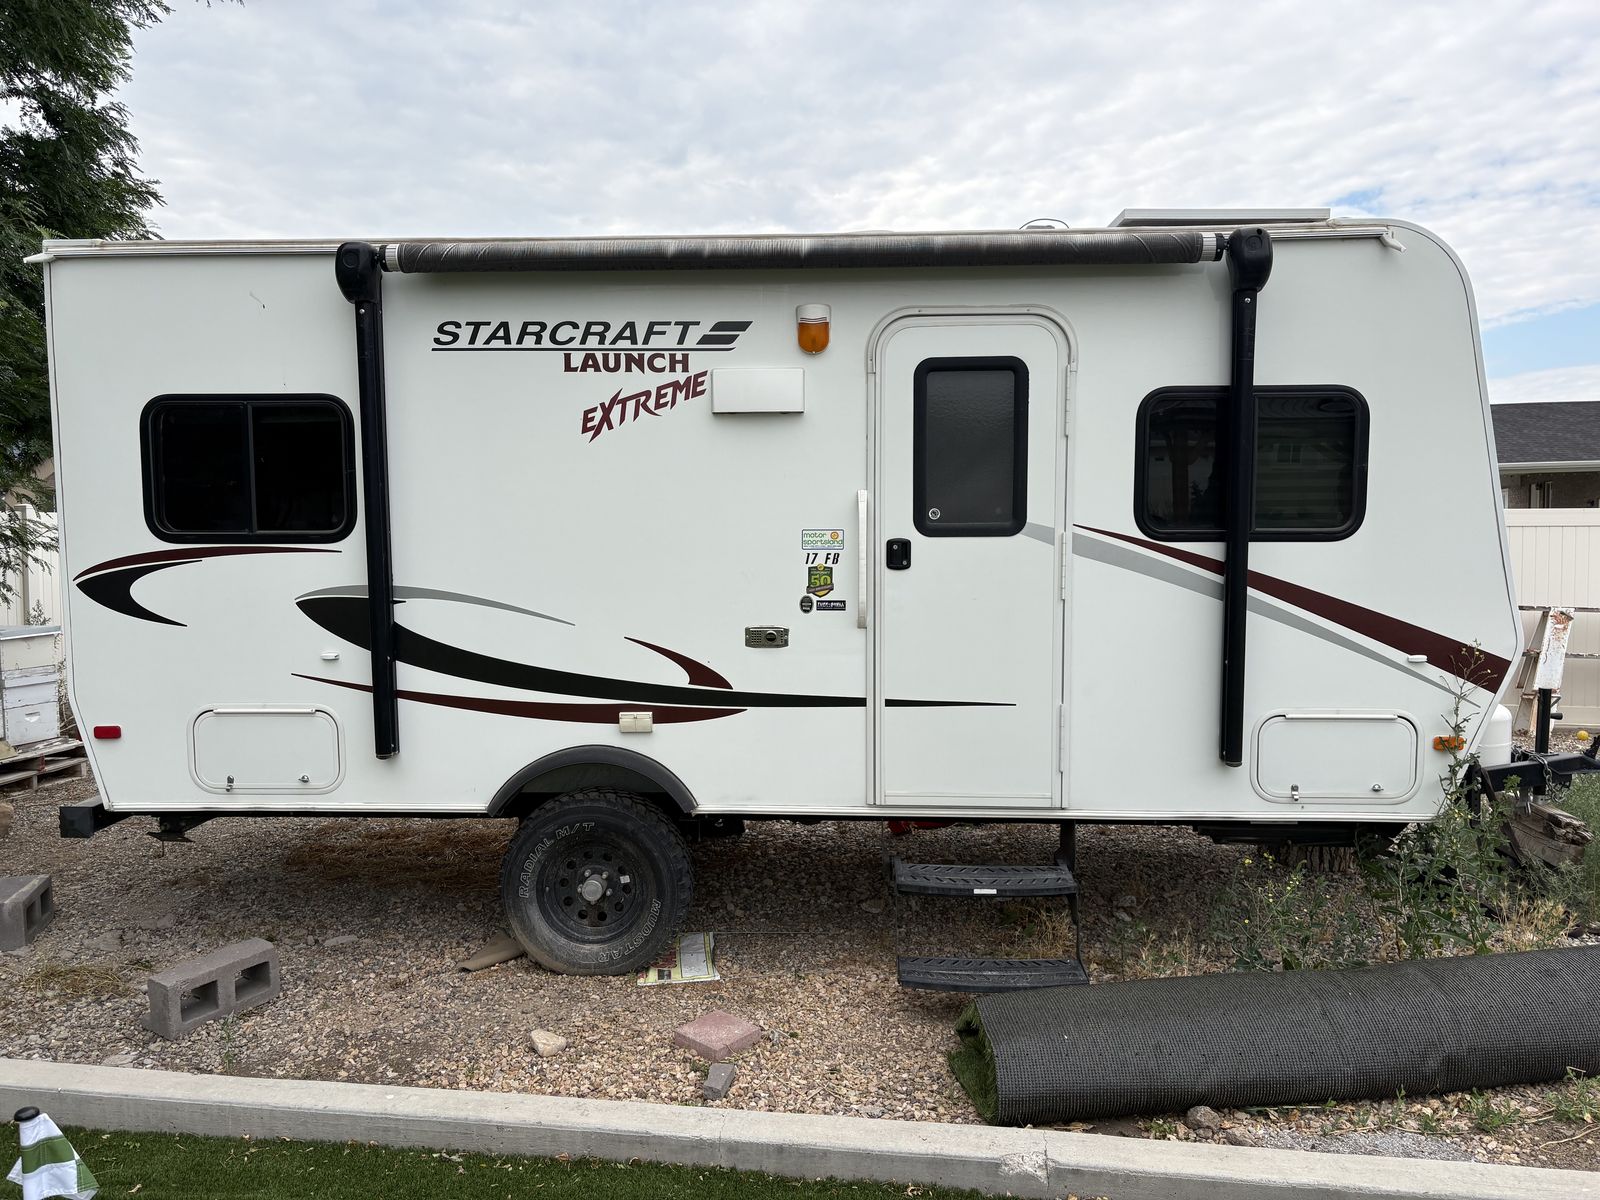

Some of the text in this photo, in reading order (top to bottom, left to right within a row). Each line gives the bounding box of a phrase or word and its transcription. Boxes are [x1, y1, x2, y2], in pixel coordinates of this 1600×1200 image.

[433, 321, 701, 346] STARCRAFT
[563, 353, 690, 375] LAUNCH
[581, 370, 709, 444] EXTREME
[803, 531, 827, 539] motor
[805, 552, 841, 565] 17 FB
[811, 575, 831, 587] 50
[518, 821, 595, 898] RADIAL M/T
[598, 899, 662, 962] MUDSTAR
